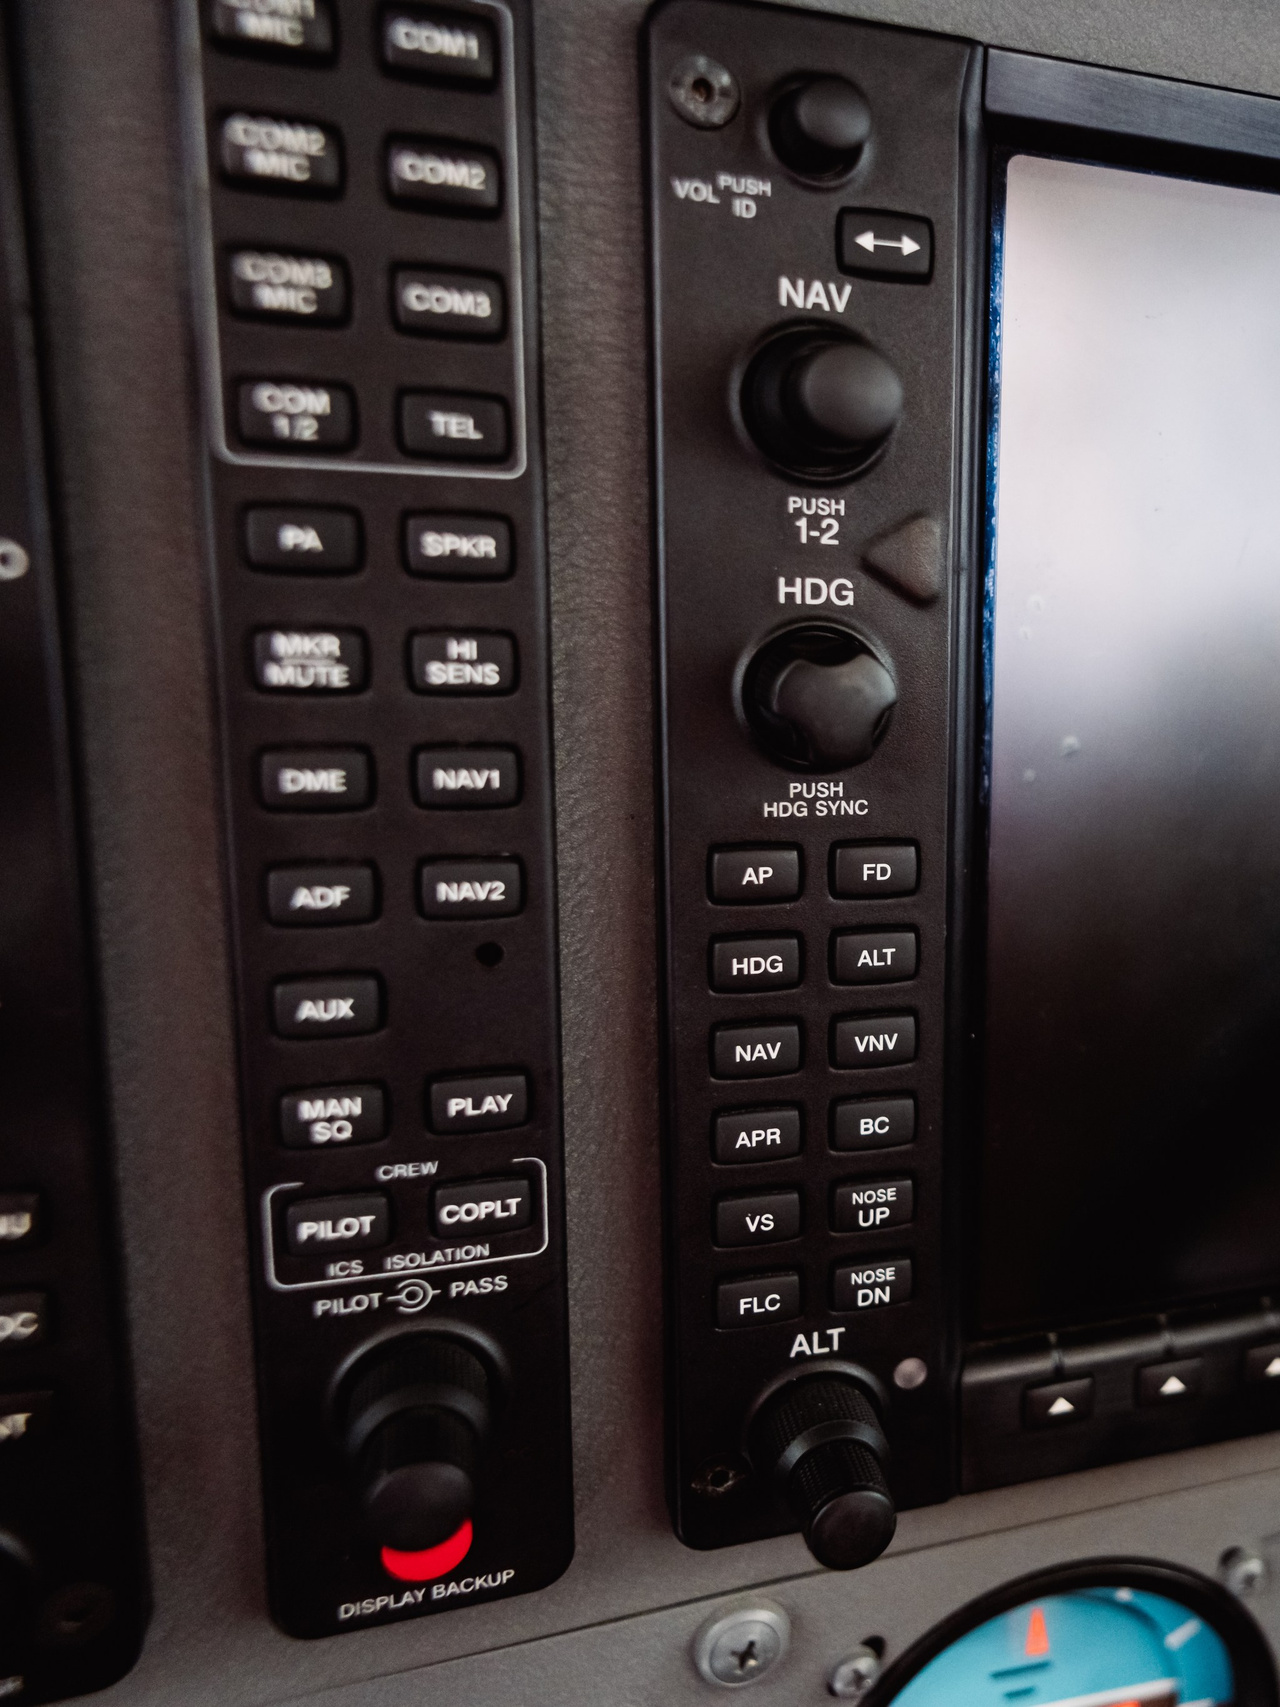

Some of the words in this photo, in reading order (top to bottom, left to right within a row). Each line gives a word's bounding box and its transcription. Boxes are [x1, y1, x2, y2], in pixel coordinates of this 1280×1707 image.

[236, 13, 304, 46] MIC
[389, 18, 479, 59] COM1
[223, 113, 326, 156] COM2
[244, 150, 311, 181] MIC
[391, 152, 486, 190] COM2
[671, 177, 721, 203] VOL
[716, 171, 772, 197] PUSH
[731, 199, 757, 219] ID
[253, 283, 318, 313] MIC
[401, 282, 492, 317] COM3
[778, 275, 852, 313] NAV
[251, 383, 331, 415] COM
[428, 410, 484, 439] TEL
[787, 496, 846, 516] PUSH
[277, 524, 324, 551] PA
[794, 517, 840, 545] 1-2
[420, 531, 497, 558] SPKR
[777, 576, 855, 606] HDG
[270, 632, 341, 656] MKR
[446, 638, 478, 660] HI
[263, 662, 350, 688] MUTE
[425, 660, 500, 685] SENS
[278, 768, 348, 793] DME
[432, 768, 501, 790] NAV1
[788, 782, 844, 798] PUSH
[763, 801, 808, 817] HDG
[814, 800, 869, 816] SYNC
[741, 866, 774, 885] AP
[862, 863, 892, 881] FD
[290, 885, 351, 910] ADF
[435, 880, 506, 902] NAV2
[731, 955, 784, 976] HDG
[857, 948, 896, 967] ALT
[295, 998, 355, 1022] AUX
[735, 1042, 782, 1063] NAV
[854, 1033, 899, 1052] VNV
[297, 1096, 363, 1122] MAN
[446, 1093, 513, 1117] PLAY
[309, 1120, 354, 1143] SQ
[735, 1127, 781, 1149] APR
[859, 1116, 890, 1136] BC
[375, 1160, 440, 1181] CREW
[851, 1187, 897, 1205] NOSE
[438, 1197, 522, 1225] COPLT
[745, 1214, 775, 1232] VS
[857, 1207, 891, 1227] UP
[297, 1215, 376, 1242] PILOT
[325, 1259, 365, 1278] ICS
[383, 1243, 490, 1271] ISOLATION
[850, 1267, 896, 1285] NOSE
[313, 1292, 383, 1317] PILOT
[449, 1275, 509, 1298] PASS
[739, 1294, 781, 1315] FLC
[857, 1286, 891, 1307] DN
[788, 1327, 846, 1358] ALT
[337, 1588, 427, 1621] DISPLAY
[431, 1568, 516, 1600] BACKUP
